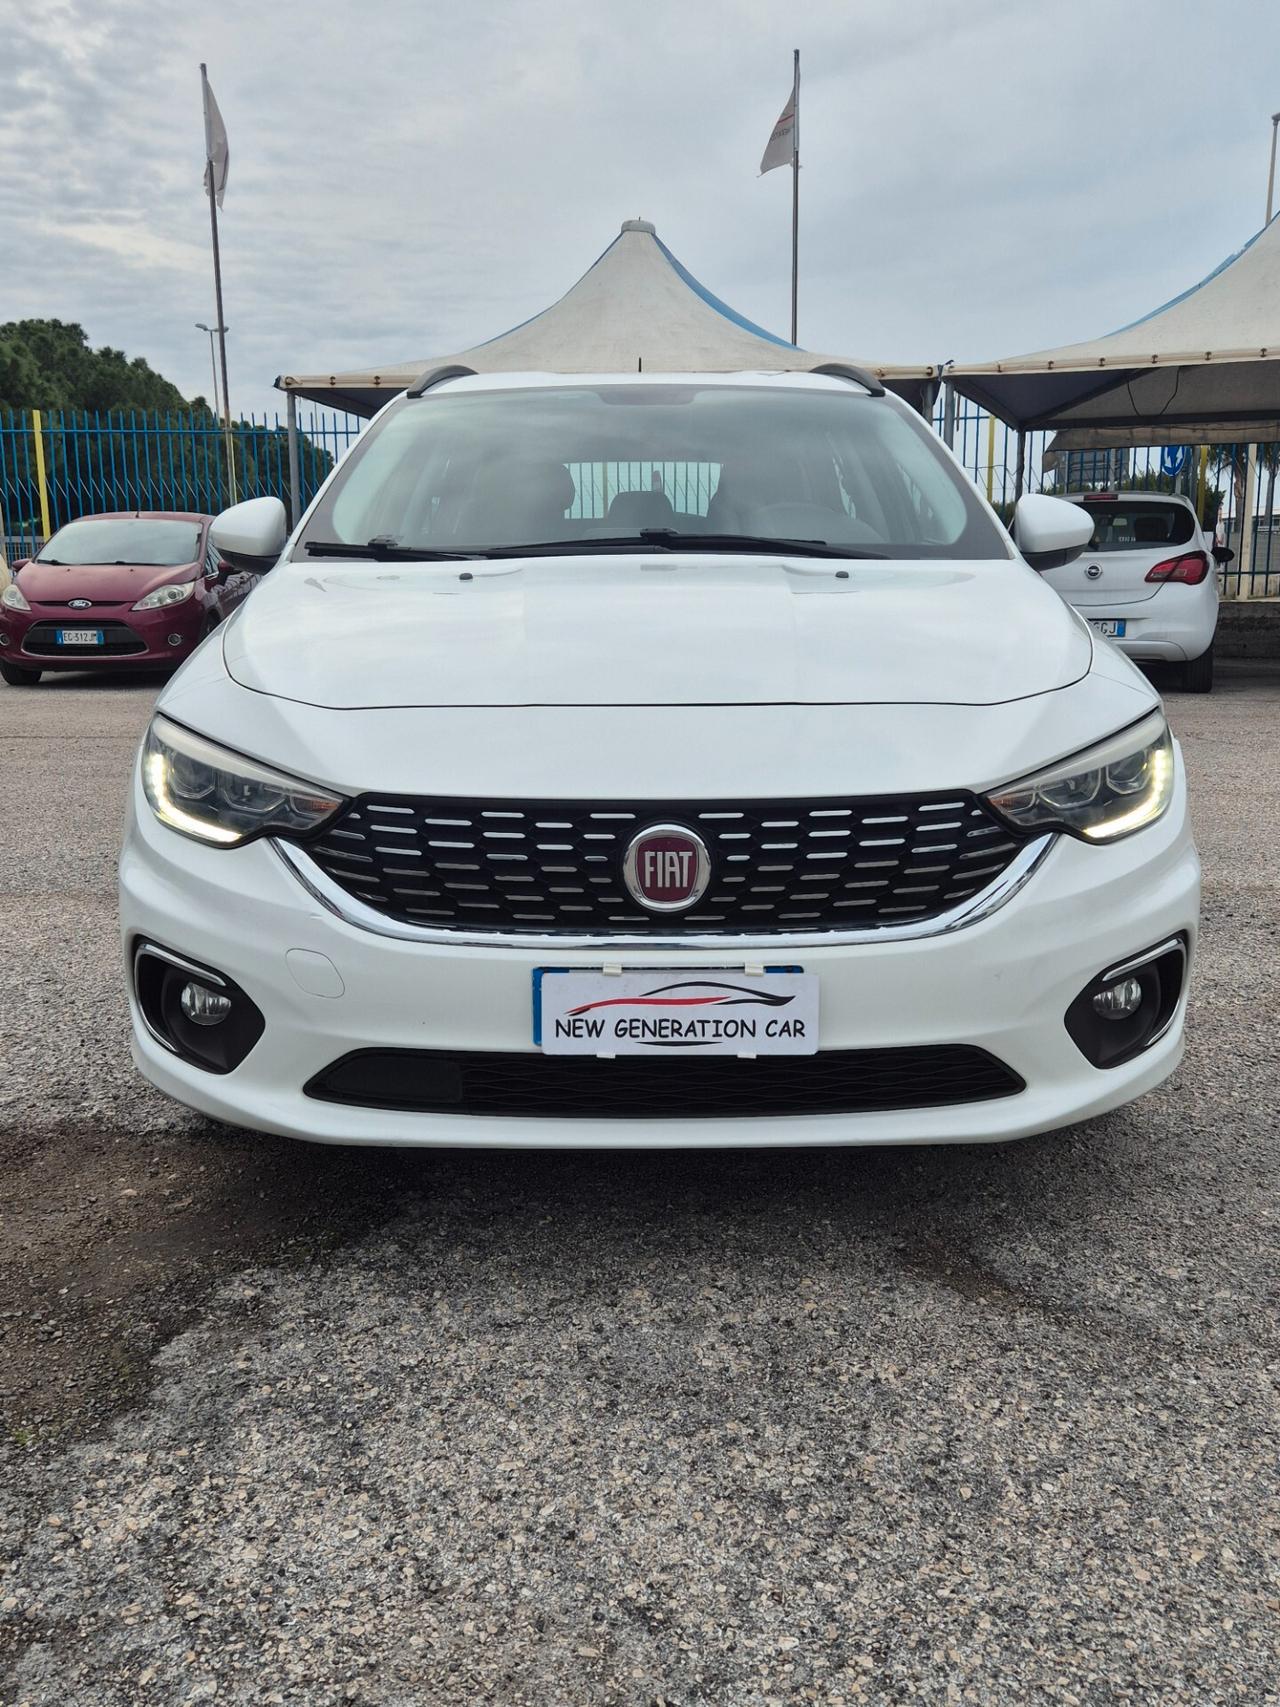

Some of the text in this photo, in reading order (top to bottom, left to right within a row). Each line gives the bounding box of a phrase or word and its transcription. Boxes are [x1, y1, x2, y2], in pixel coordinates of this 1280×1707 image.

[644, 851, 693, 888] FIAT
[555, 1018, 806, 1039] NEW GENERATION CAR
